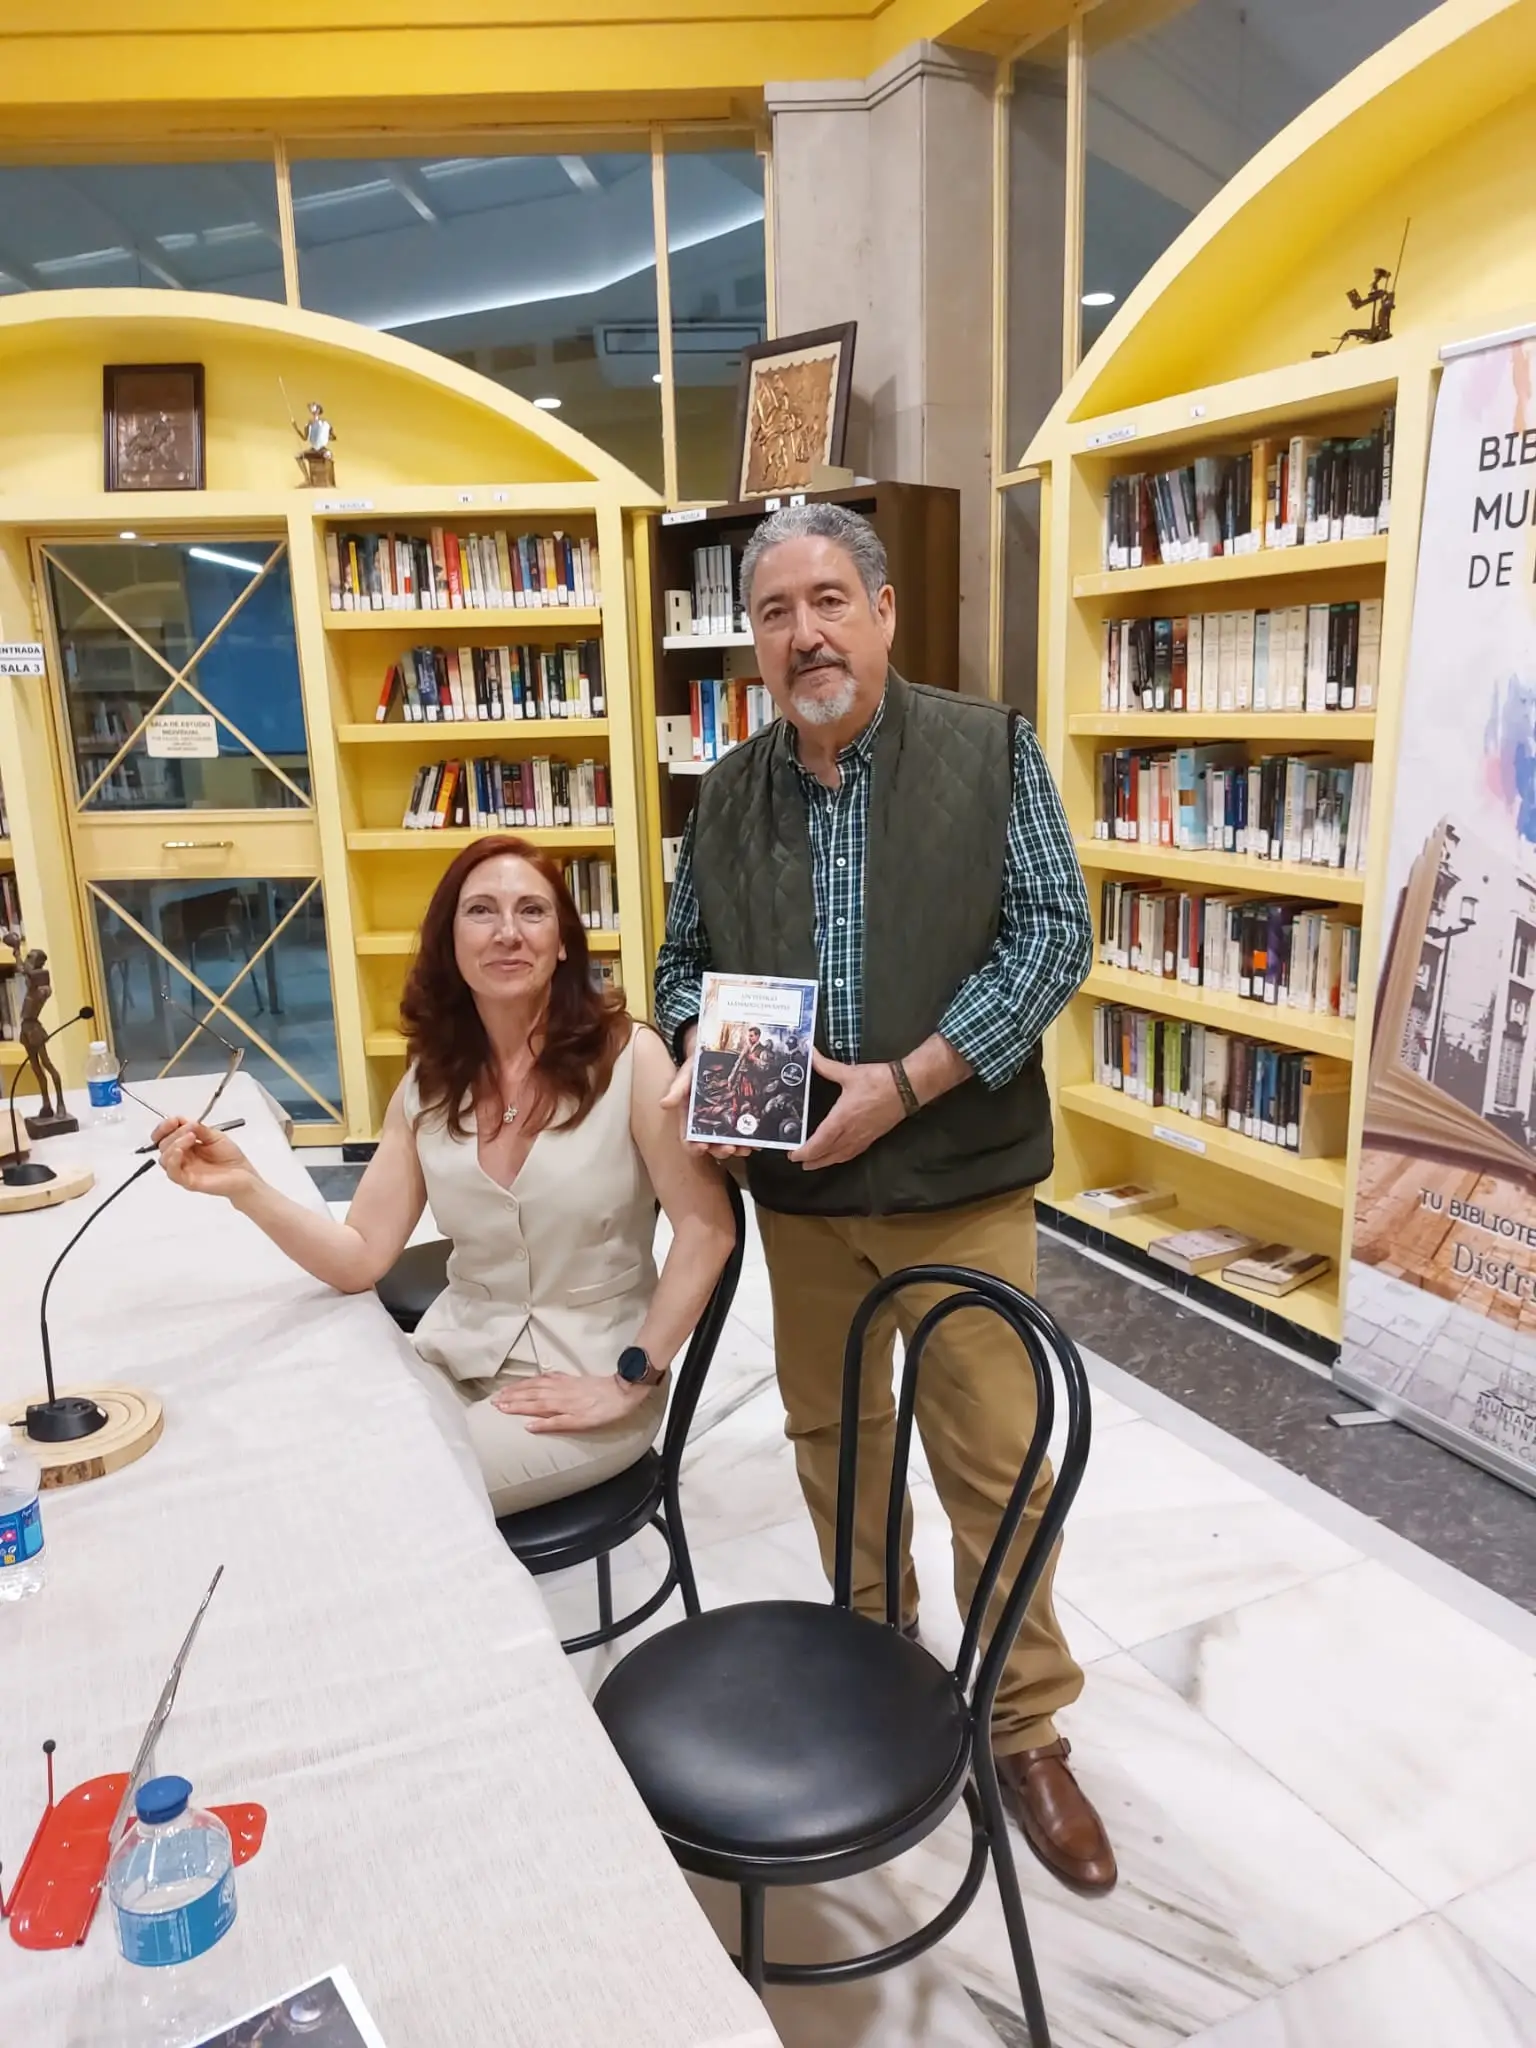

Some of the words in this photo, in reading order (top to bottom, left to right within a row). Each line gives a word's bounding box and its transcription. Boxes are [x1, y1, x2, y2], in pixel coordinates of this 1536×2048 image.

[1473, 489, 1536, 533] MU
[1468, 552, 1513, 588] DE
[0, 646, 41, 654] NTRADA
[0, 663, 30, 673] SALA
[34, 663, 41, 673] 3
[1420, 1187, 1443, 1210] TU
[1449, 1199, 1536, 1247] BIBLIOTE
[1453, 1242, 1536, 1303] Disfr
